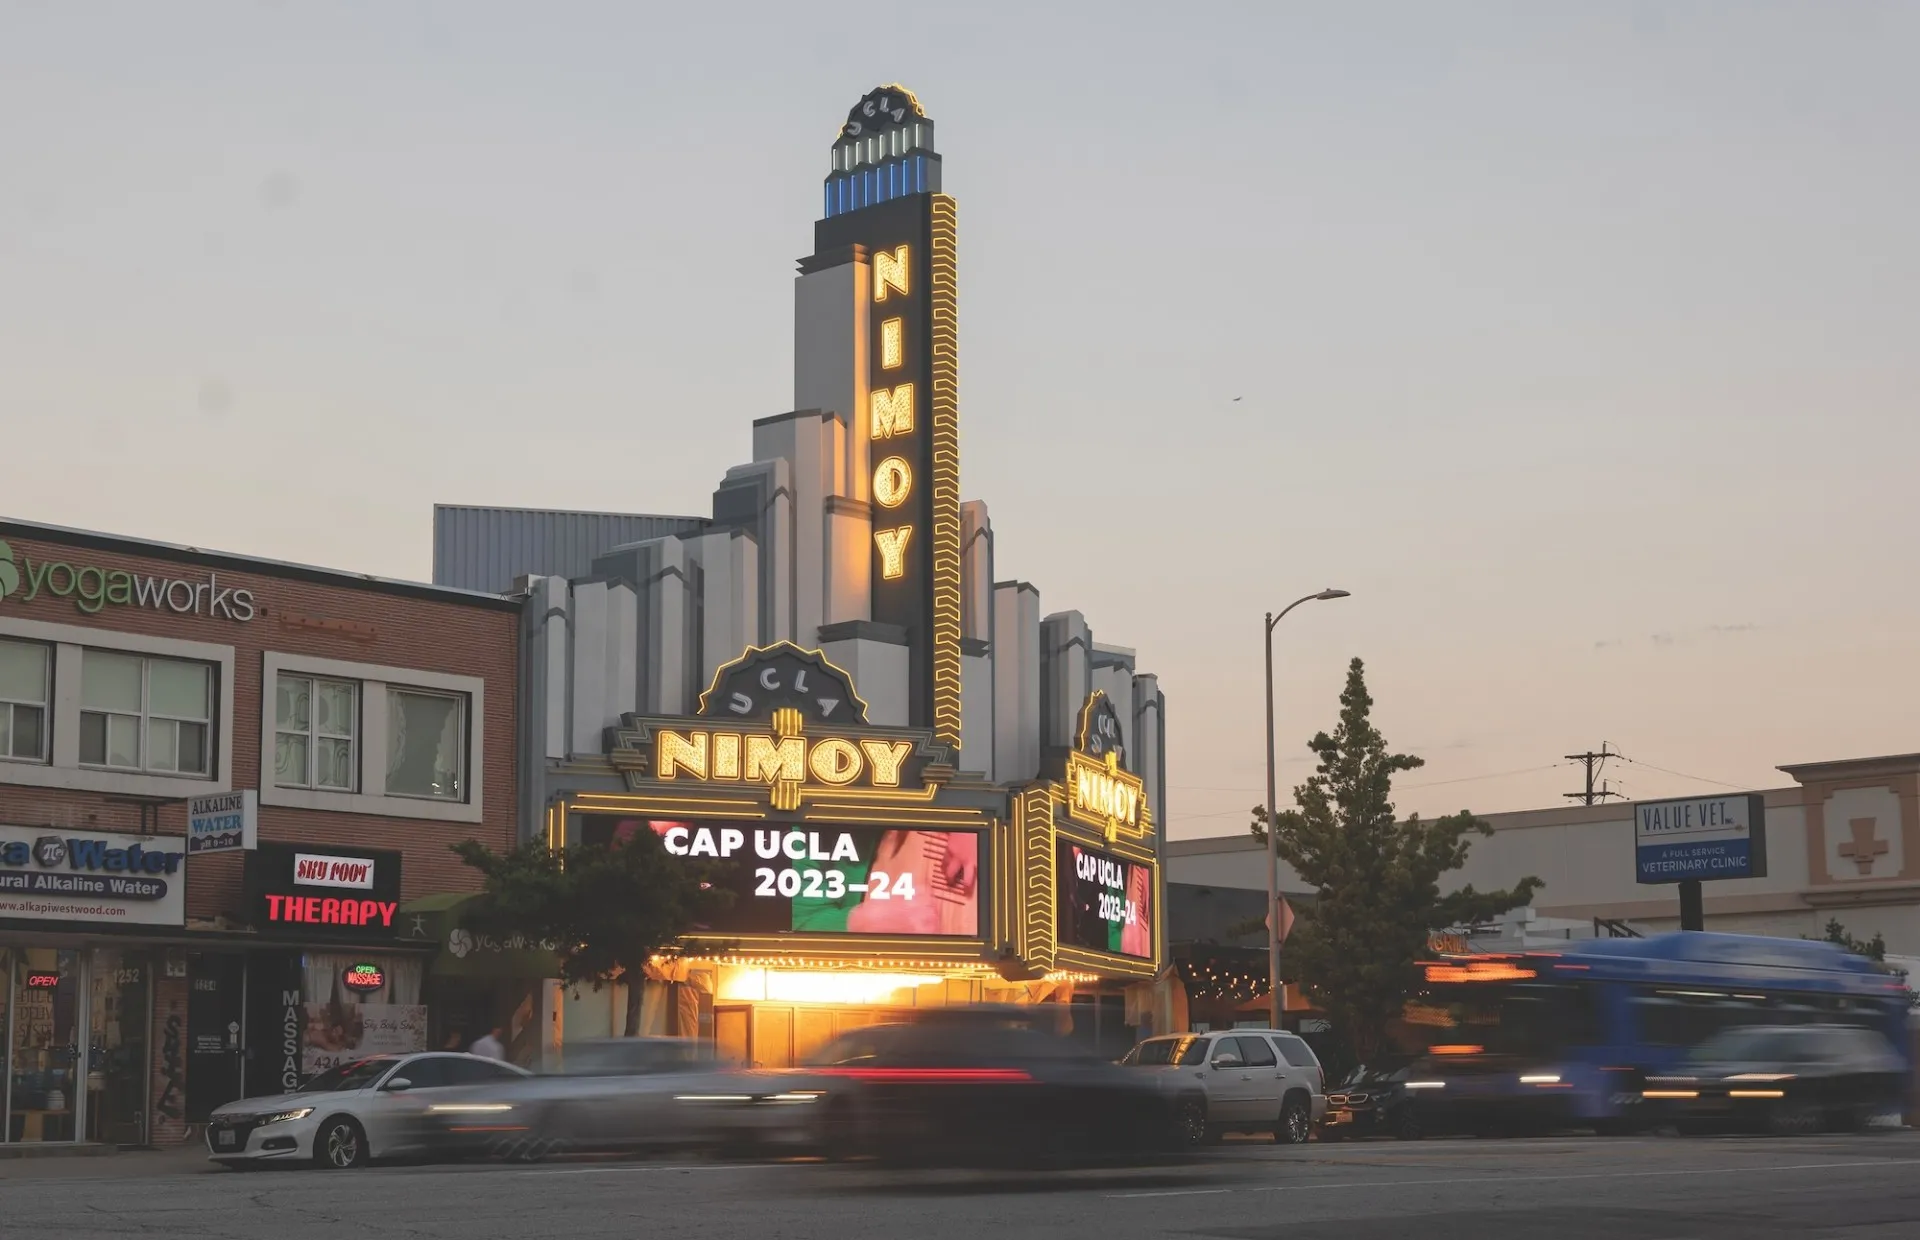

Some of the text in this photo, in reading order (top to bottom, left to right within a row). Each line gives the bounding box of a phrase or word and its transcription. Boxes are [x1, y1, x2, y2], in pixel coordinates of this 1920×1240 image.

[847, 97, 905, 136] UCLA
[871, 245, 914, 579] NIMOY
[23, 558, 254, 621] yogaworks
[729, 668, 840, 717] UCLA
[658, 730, 912, 787] NIMOY
[192, 795, 242, 815] ALKALINE
[1076, 764, 1138, 827] NIMOY
[192, 814, 242, 833] WATER
[1643, 805, 1691, 831] VALUE
[1699, 801, 1726, 827] VET
[0, 839, 184, 873] a Water
[664, 827, 859, 862] CAP UCLA
[1669, 850, 1689, 858] FULL
[1692, 847, 1725, 856] SERVICE
[1076, 851, 1124, 890] CAP UCLA
[1642, 856, 1747, 873] VETERINARY CLINIC
[35, 875, 104, 892] Alkaline
[110, 879, 159, 895] Water
[265, 894, 397, 927] THERAPY
[29, 975, 58, 986] OPEN
[113, 969, 140, 983] 1252
[355, 966, 376, 975] OPEN
[282, 990, 299, 1094] MASSAG
